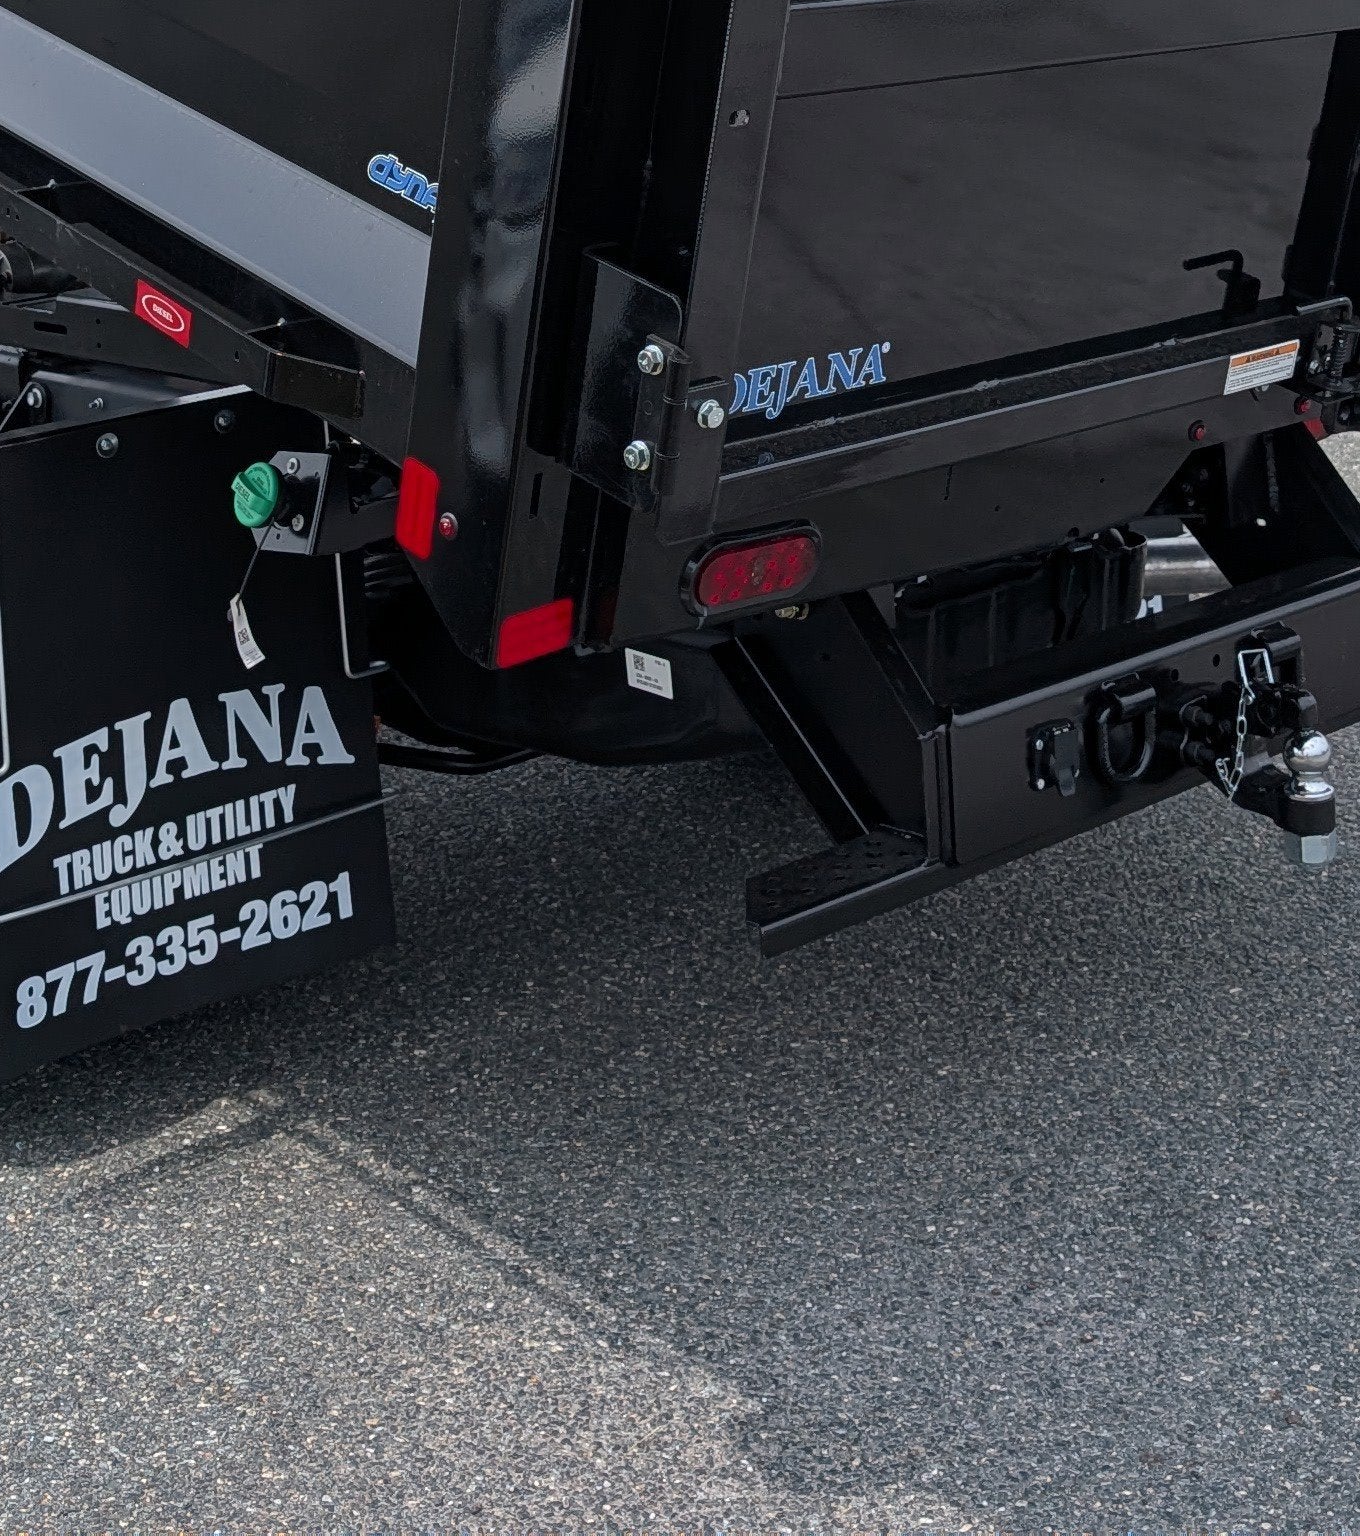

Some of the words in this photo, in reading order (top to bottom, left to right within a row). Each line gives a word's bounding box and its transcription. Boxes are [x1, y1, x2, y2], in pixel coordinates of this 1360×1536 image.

[368, 154, 439, 213] dyna
[94, 843, 264, 930] EQUIPMENT
[16, 871, 353, 1029] 877-335-2621
